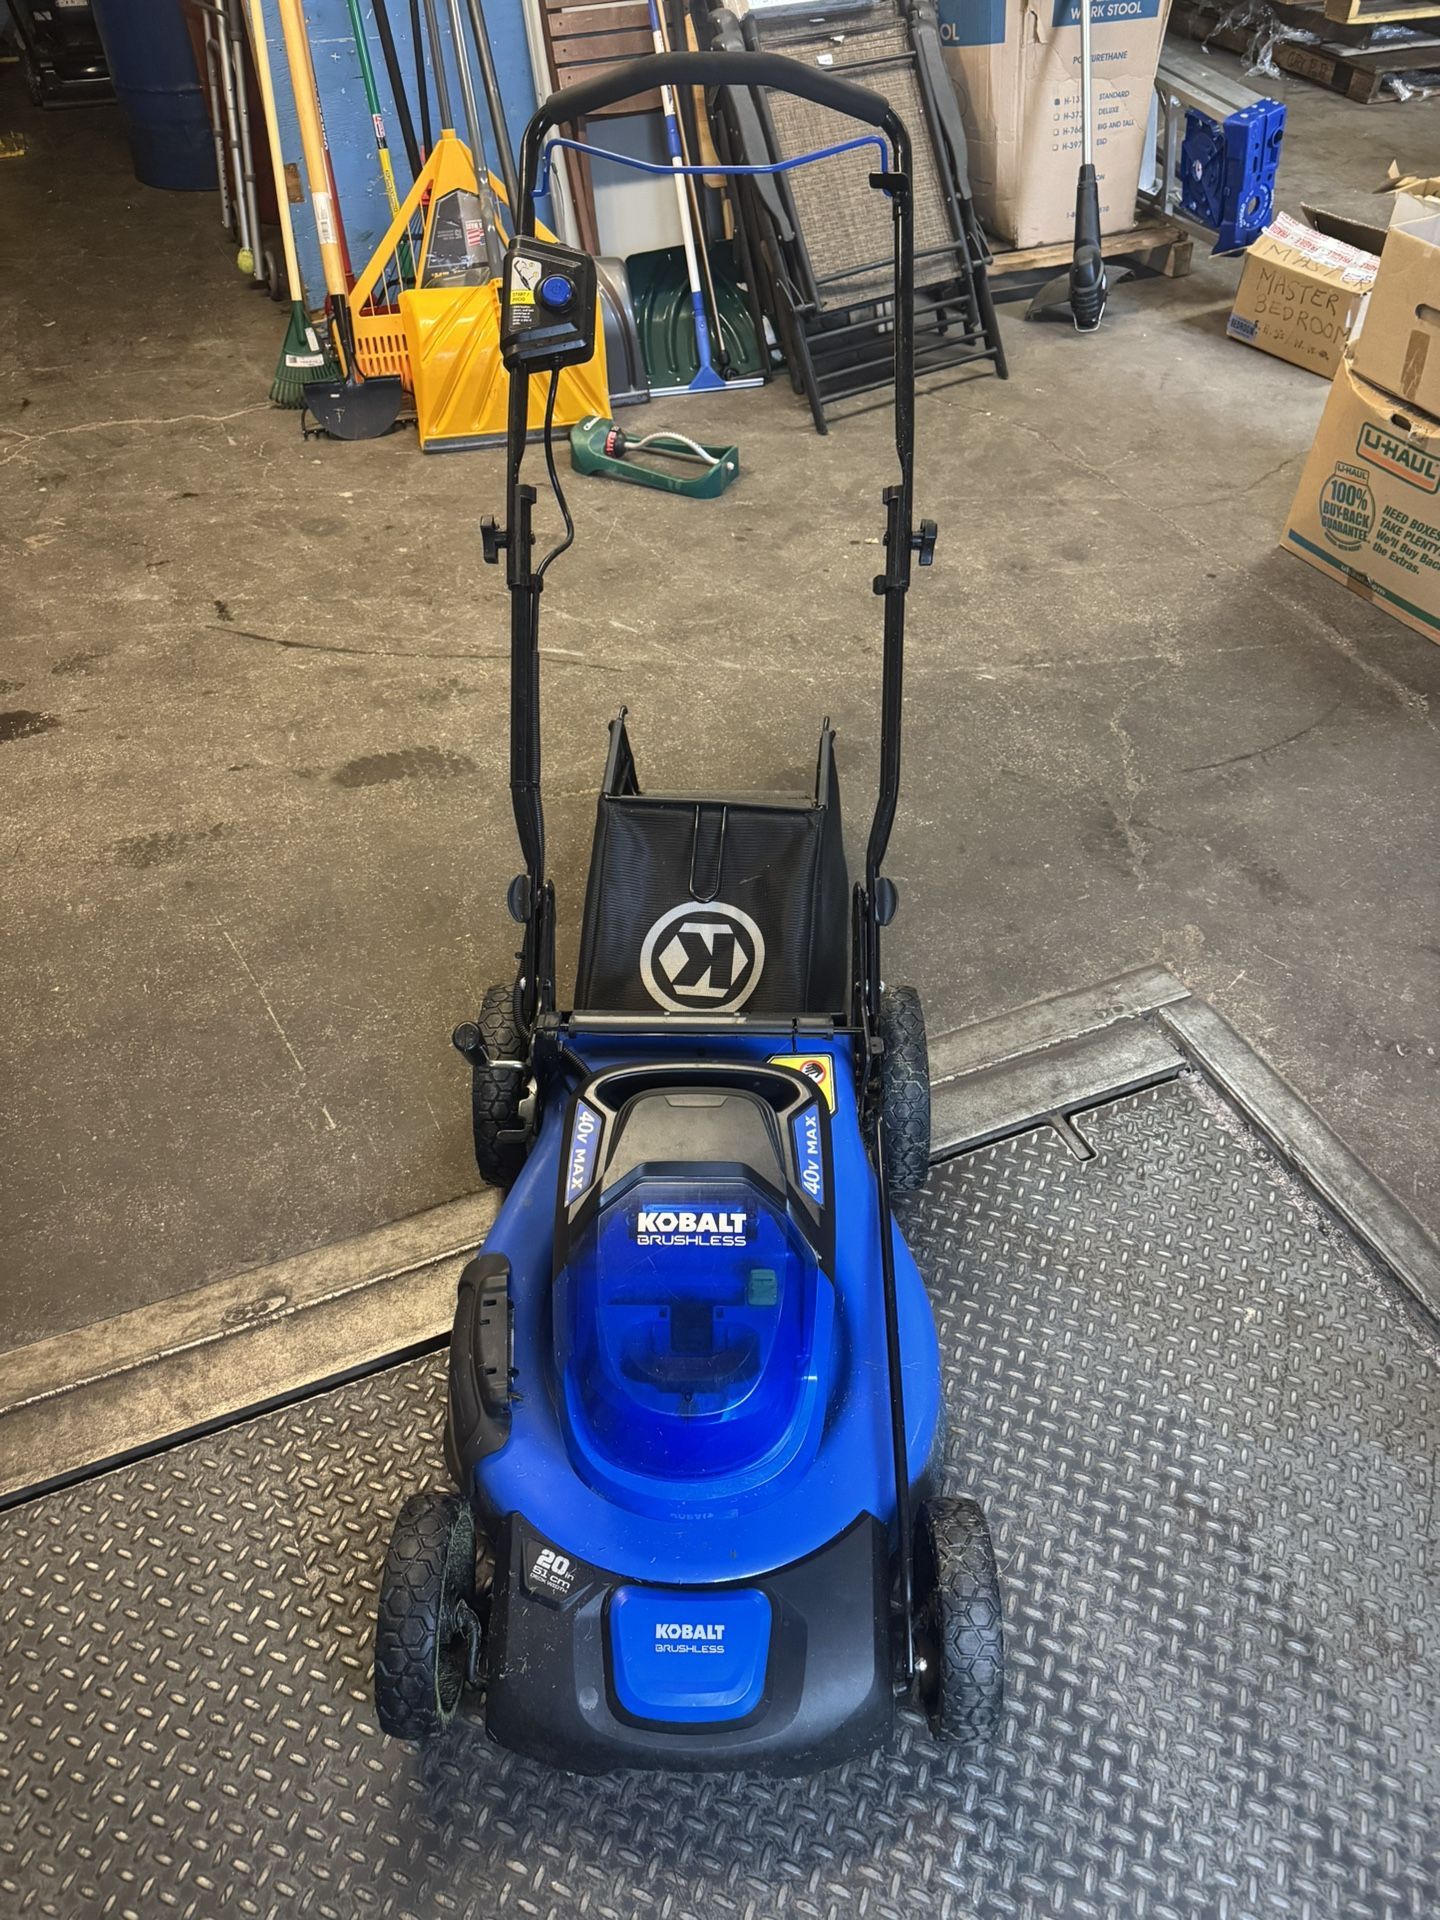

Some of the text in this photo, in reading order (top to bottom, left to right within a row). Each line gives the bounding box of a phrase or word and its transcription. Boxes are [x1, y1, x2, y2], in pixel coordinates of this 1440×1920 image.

[1070, 3, 1142, 20] WRK STOOL
[1072, 51, 1128, 64] POURETHANE
[1099, 90, 1130, 100] STANDARD
[1098, 106, 1119, 115] DELUXE
[1097, 122, 1107, 131] BIG
[1108, 121, 1121, 130] AND
[1123, 119, 1134, 127] TALL
[1256, 267, 1340, 316] MASTER
[1254, 294, 1351, 344] BEDROOM
[1364, 429, 1436, 480] U-HAUL
[1337, 463, 1367, 479] U-HAUL
[1331, 479, 1368, 511] 100%
[1323, 501, 1370, 528] BUY-BACK
[1382, 505, 1409, 525] NEED
[1380, 517, 1403, 537] TAKE
[1372, 542, 1420, 575] the Extras.
[1376, 529, 1399, 548] We'll
[1399, 543, 1419, 560] Buy
[1419, 553, 1440, 571] Bac
[804, 1115, 818, 1155] MAX
[570, 1148, 586, 1189] MAX
[637, 1213, 747, 1233] KOBALT
[636, 1235, 747, 1246] BRUSHLESS
[529, 1572, 568, 1594] DECK WIDTH
[532, 1564, 571, 1589] 51 cm
[655, 1623, 725, 1640] KOBALT
[655, 1644, 725, 1654] BRUSHLESS
